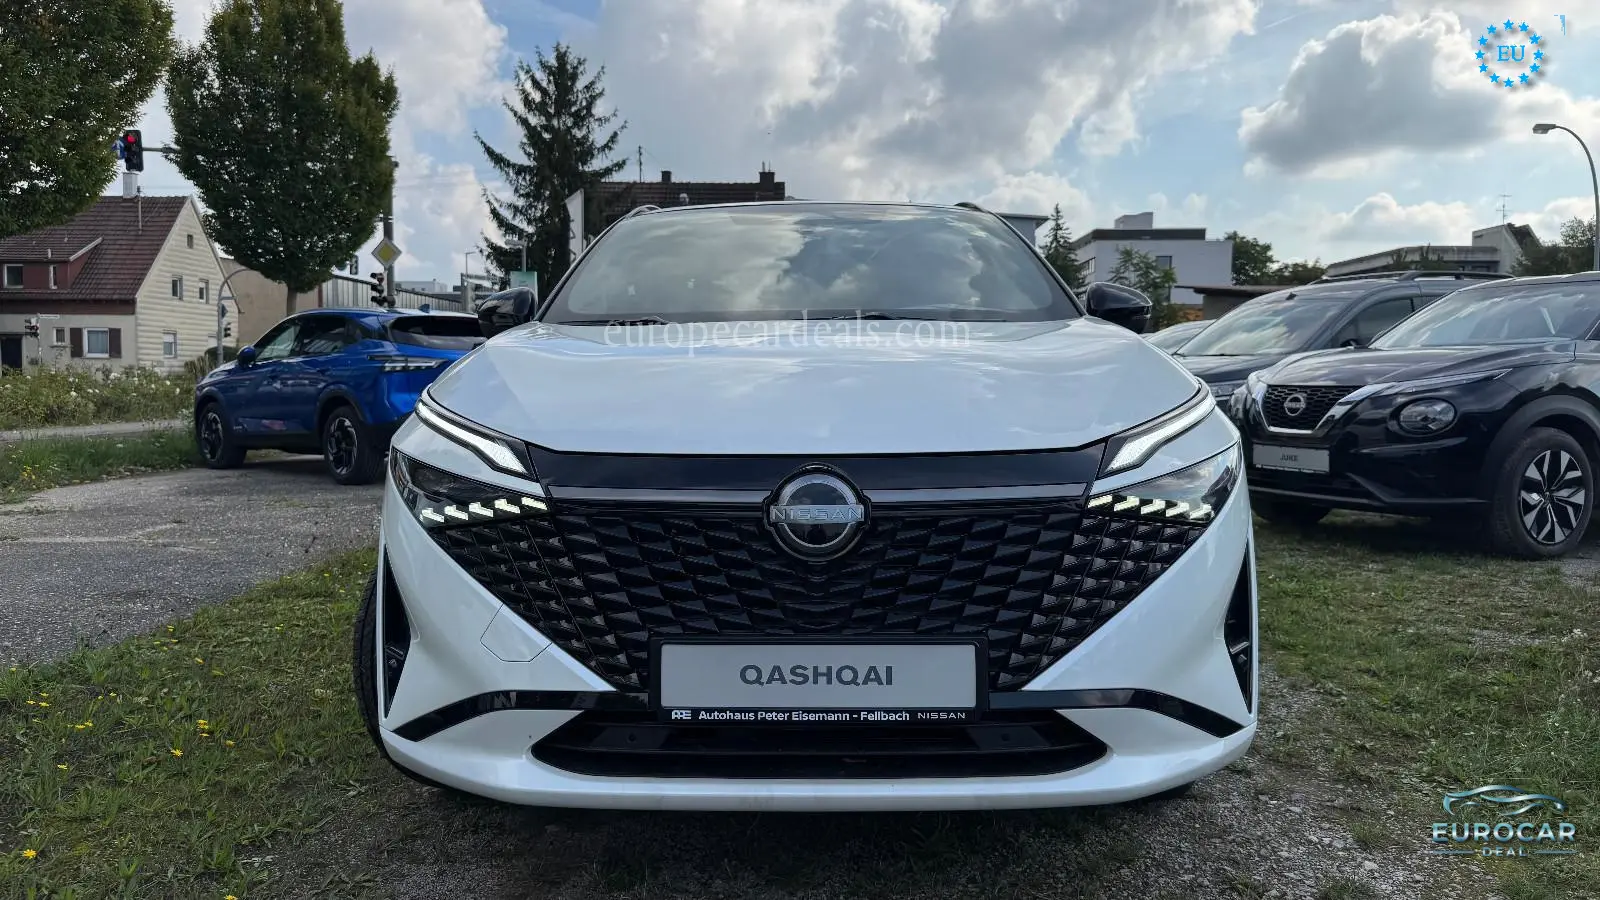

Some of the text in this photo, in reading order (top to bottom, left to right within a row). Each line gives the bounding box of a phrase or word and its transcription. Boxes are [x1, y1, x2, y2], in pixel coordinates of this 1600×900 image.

[771, 508, 864, 521] NISSAN
[739, 664, 893, 686] QASHQAI
[698, 710, 755, 720] Autohaus
[757, 711, 790, 721] Peter
[791, 711, 850, 721] Eisemann
[860, 711, 910, 721] Fellbach
